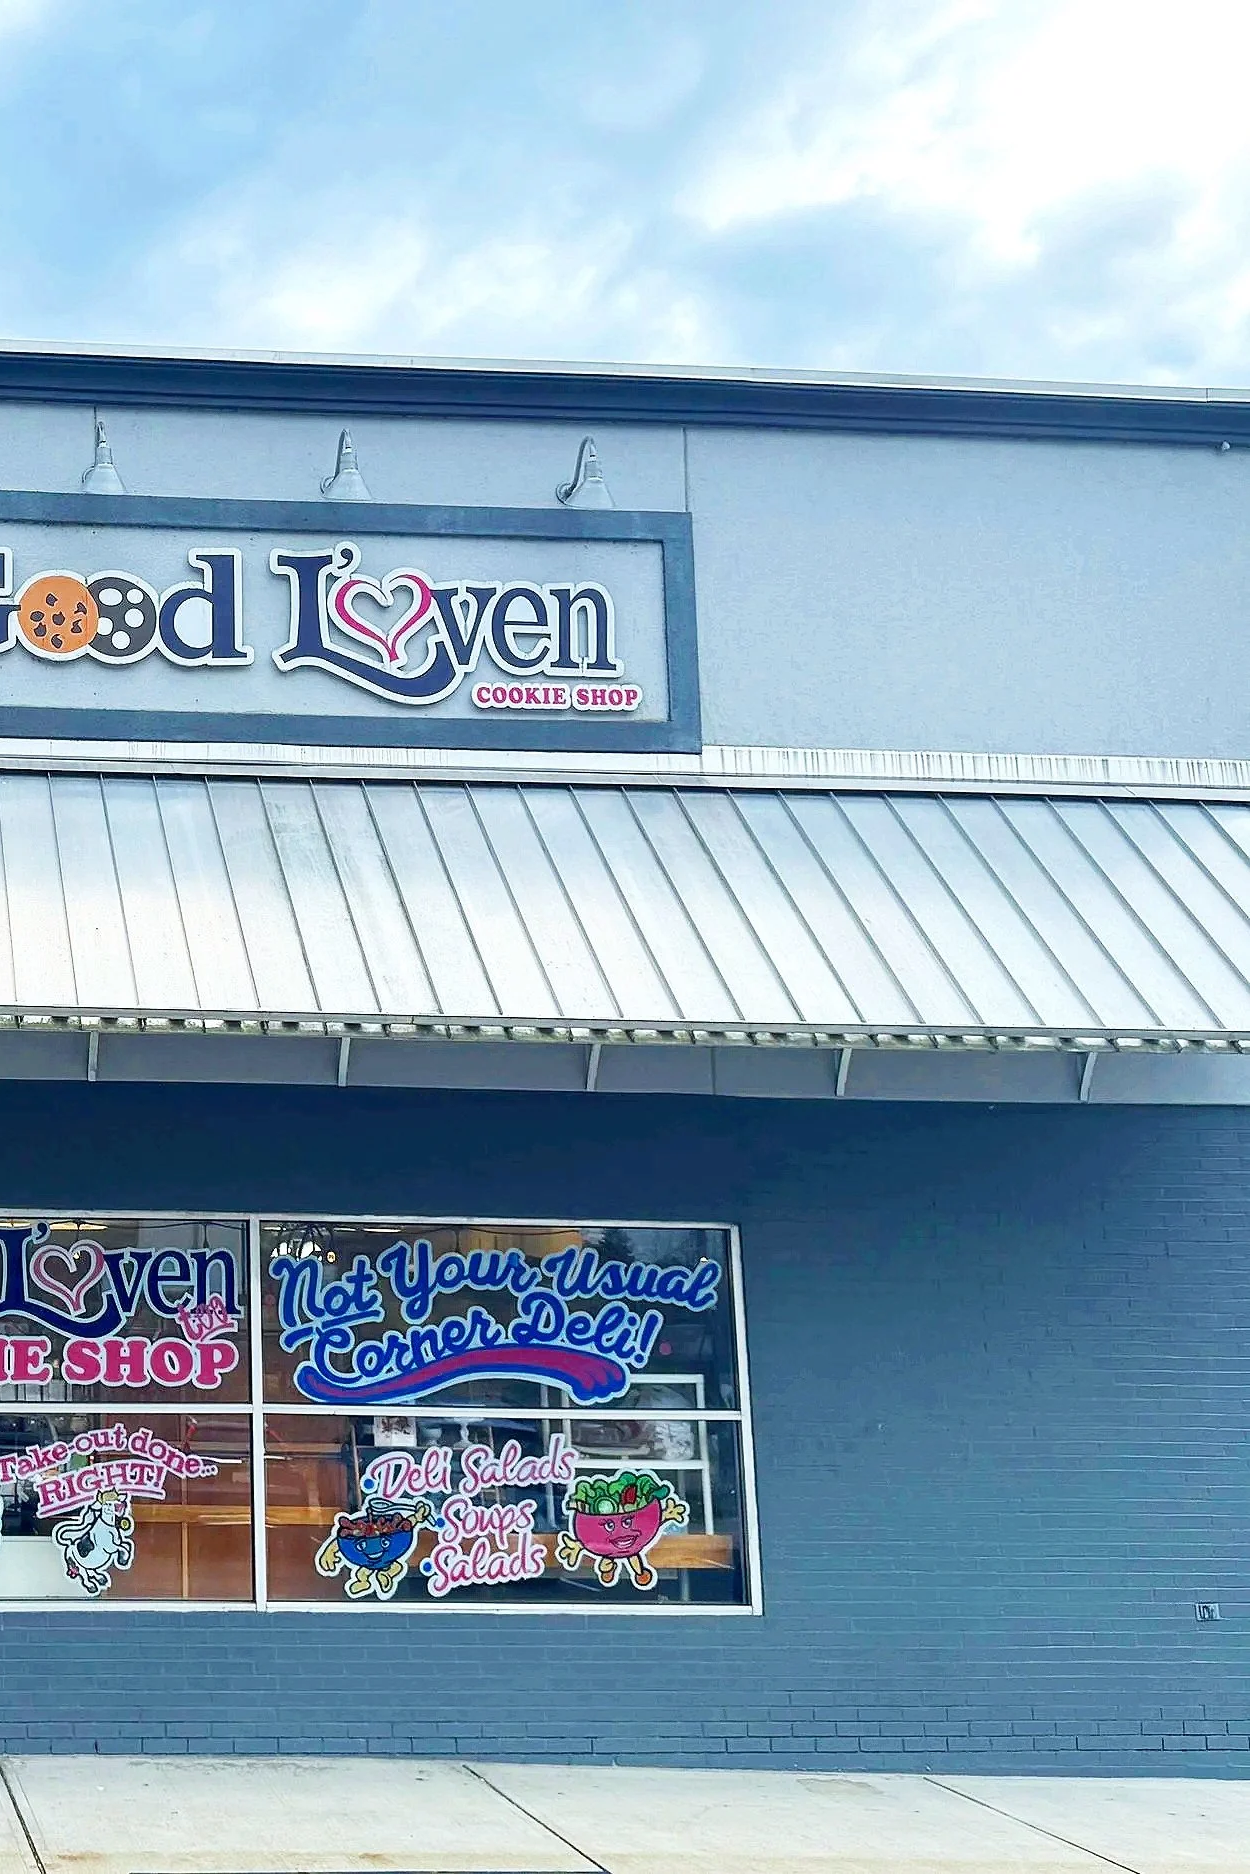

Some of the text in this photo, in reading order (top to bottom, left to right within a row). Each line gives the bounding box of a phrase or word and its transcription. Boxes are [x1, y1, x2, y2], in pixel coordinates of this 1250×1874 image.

[477, 687, 638, 706] COOKIE SHOP
[272, 1241, 718, 1327] Not Your Usual
[63, 1338, 237, 1387] SHOP
[290, 1292, 662, 1382] Corner Deli!
[37, 1460, 164, 1507] RIGHT!
[370, 1434, 575, 1499] Deli Salads
[441, 1500, 534, 1546] Soups
[430, 1532, 544, 1594] Salads
